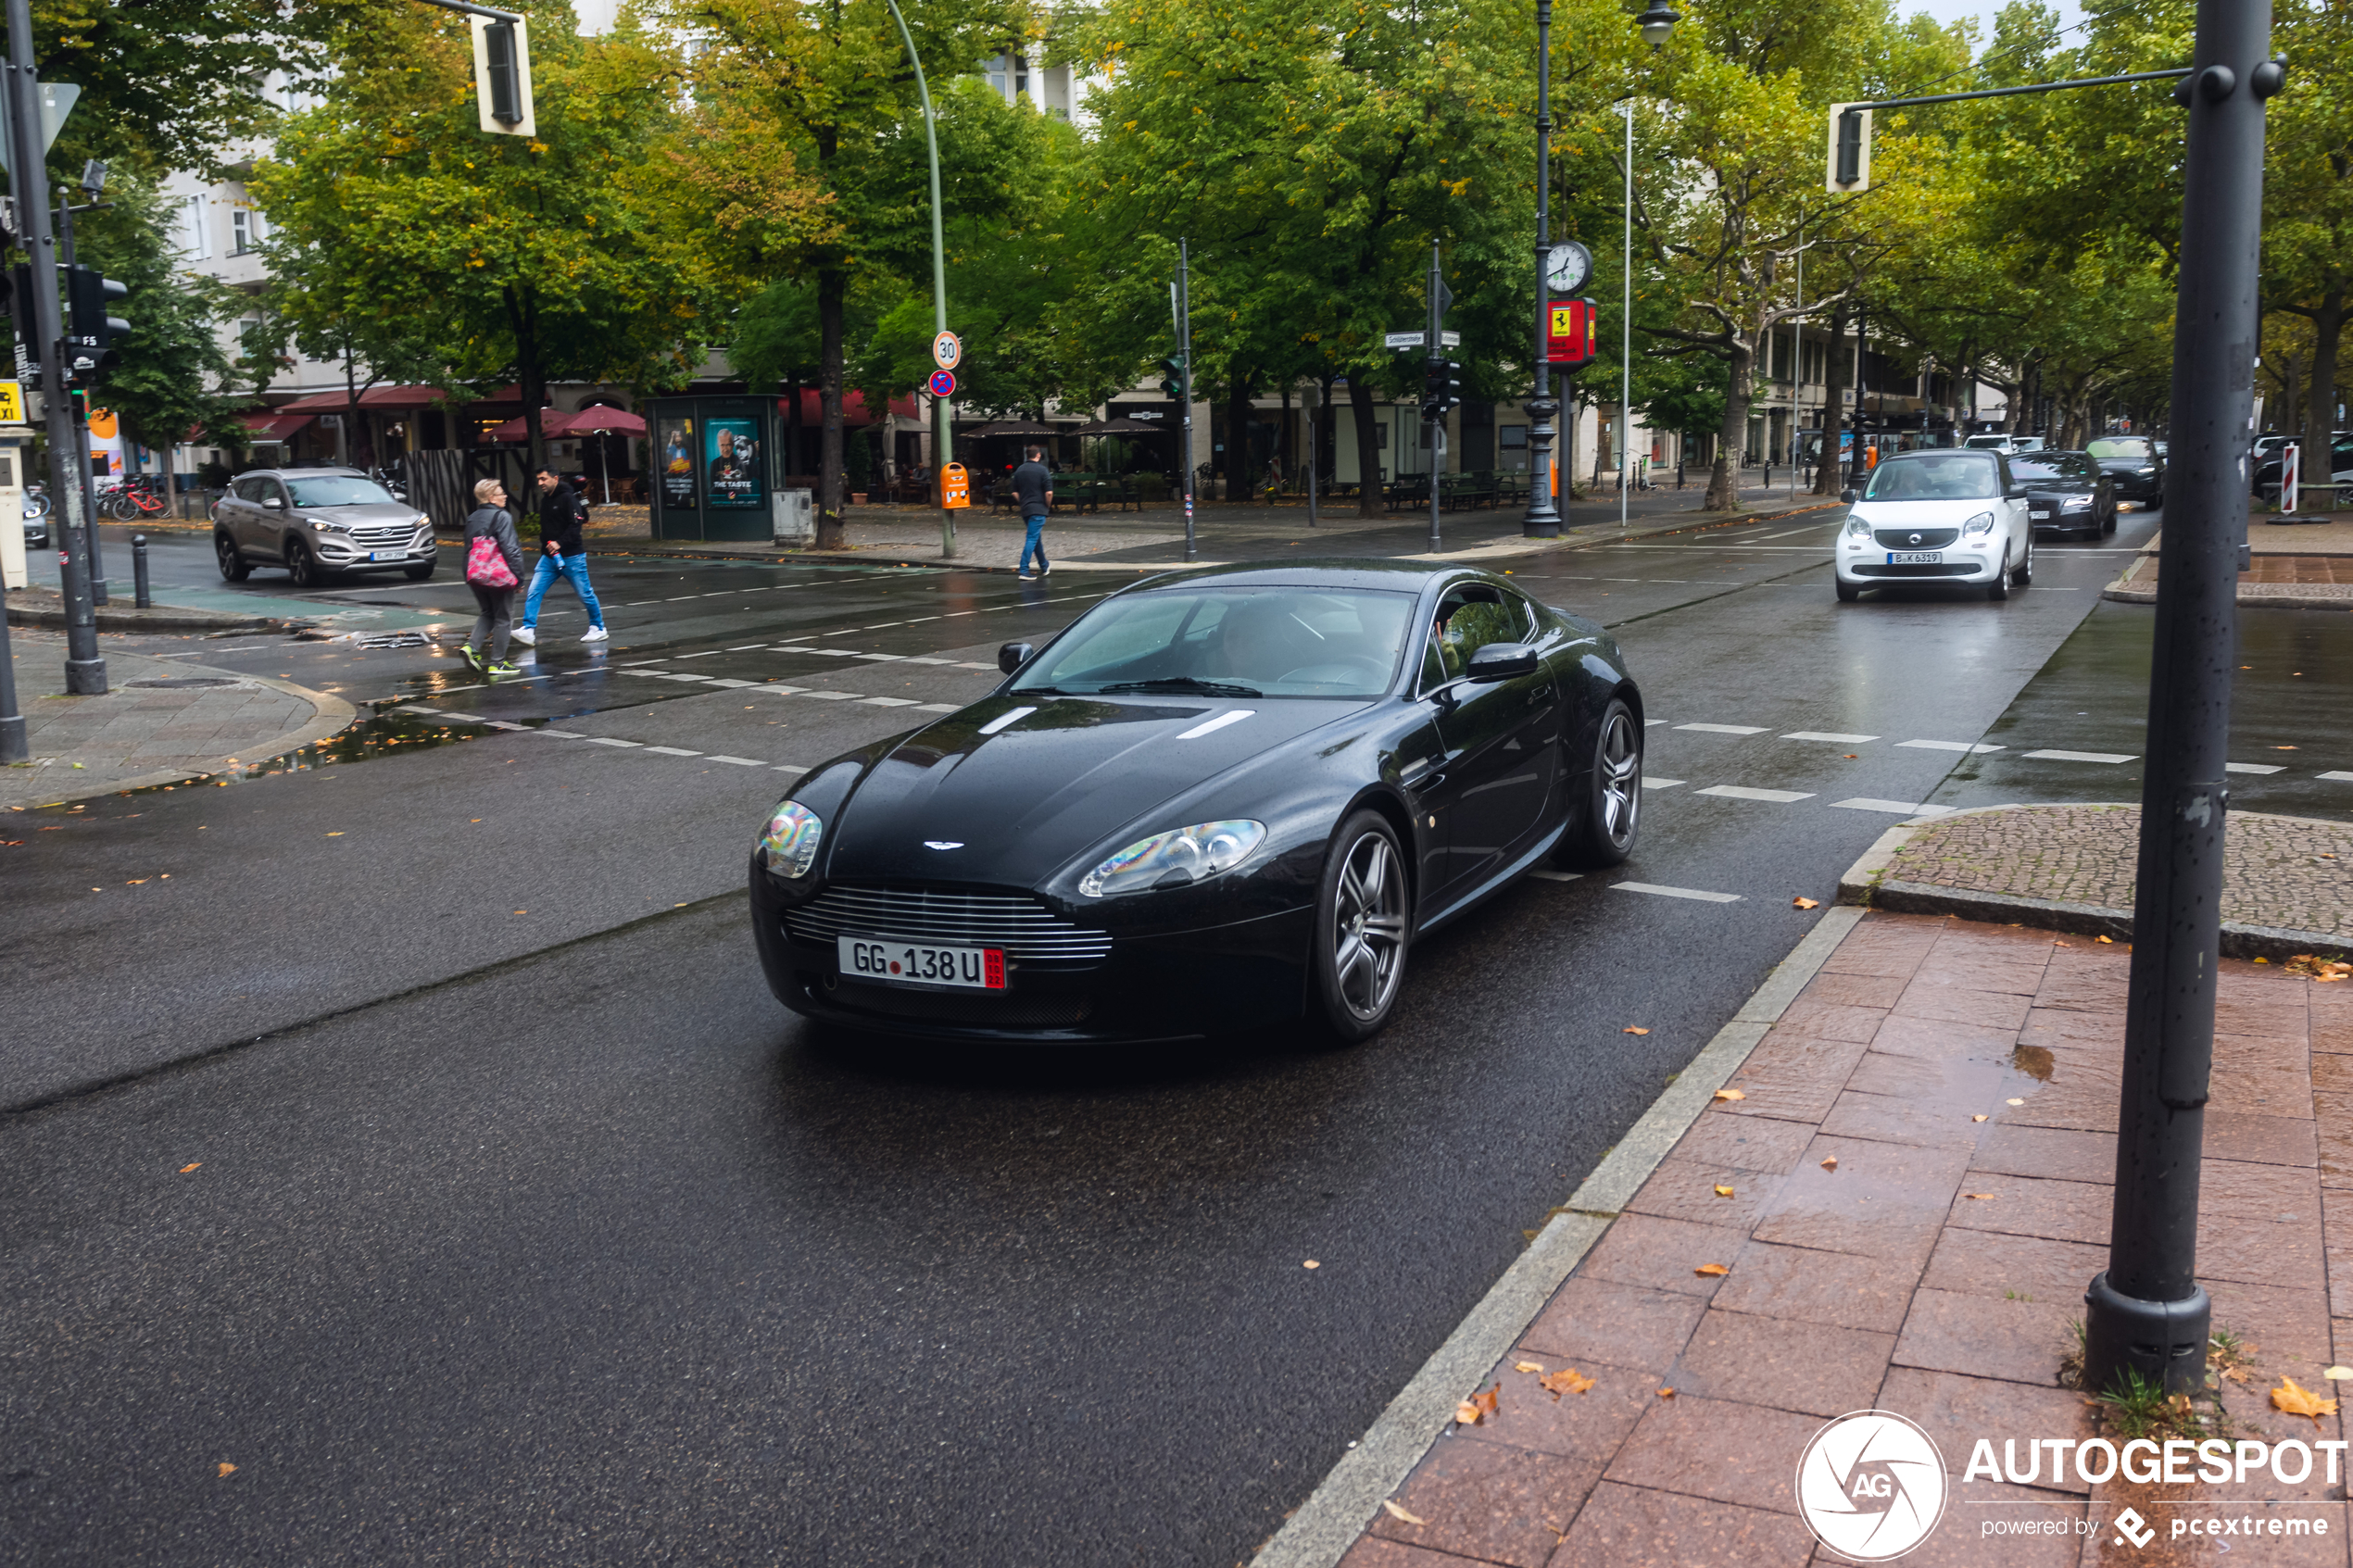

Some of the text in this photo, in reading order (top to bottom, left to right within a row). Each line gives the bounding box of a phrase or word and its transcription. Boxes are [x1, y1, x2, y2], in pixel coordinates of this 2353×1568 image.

[939, 342, 955, 358] 30
[0, 408, 13, 420] XI
[1895, 553, 1938, 562] B K 6319
[853, 942, 980, 983] GG 138 U
[988, 954, 1000, 962] 08
[988, 964, 1000, 973] 10
[988, 975, 1000, 984] 22
